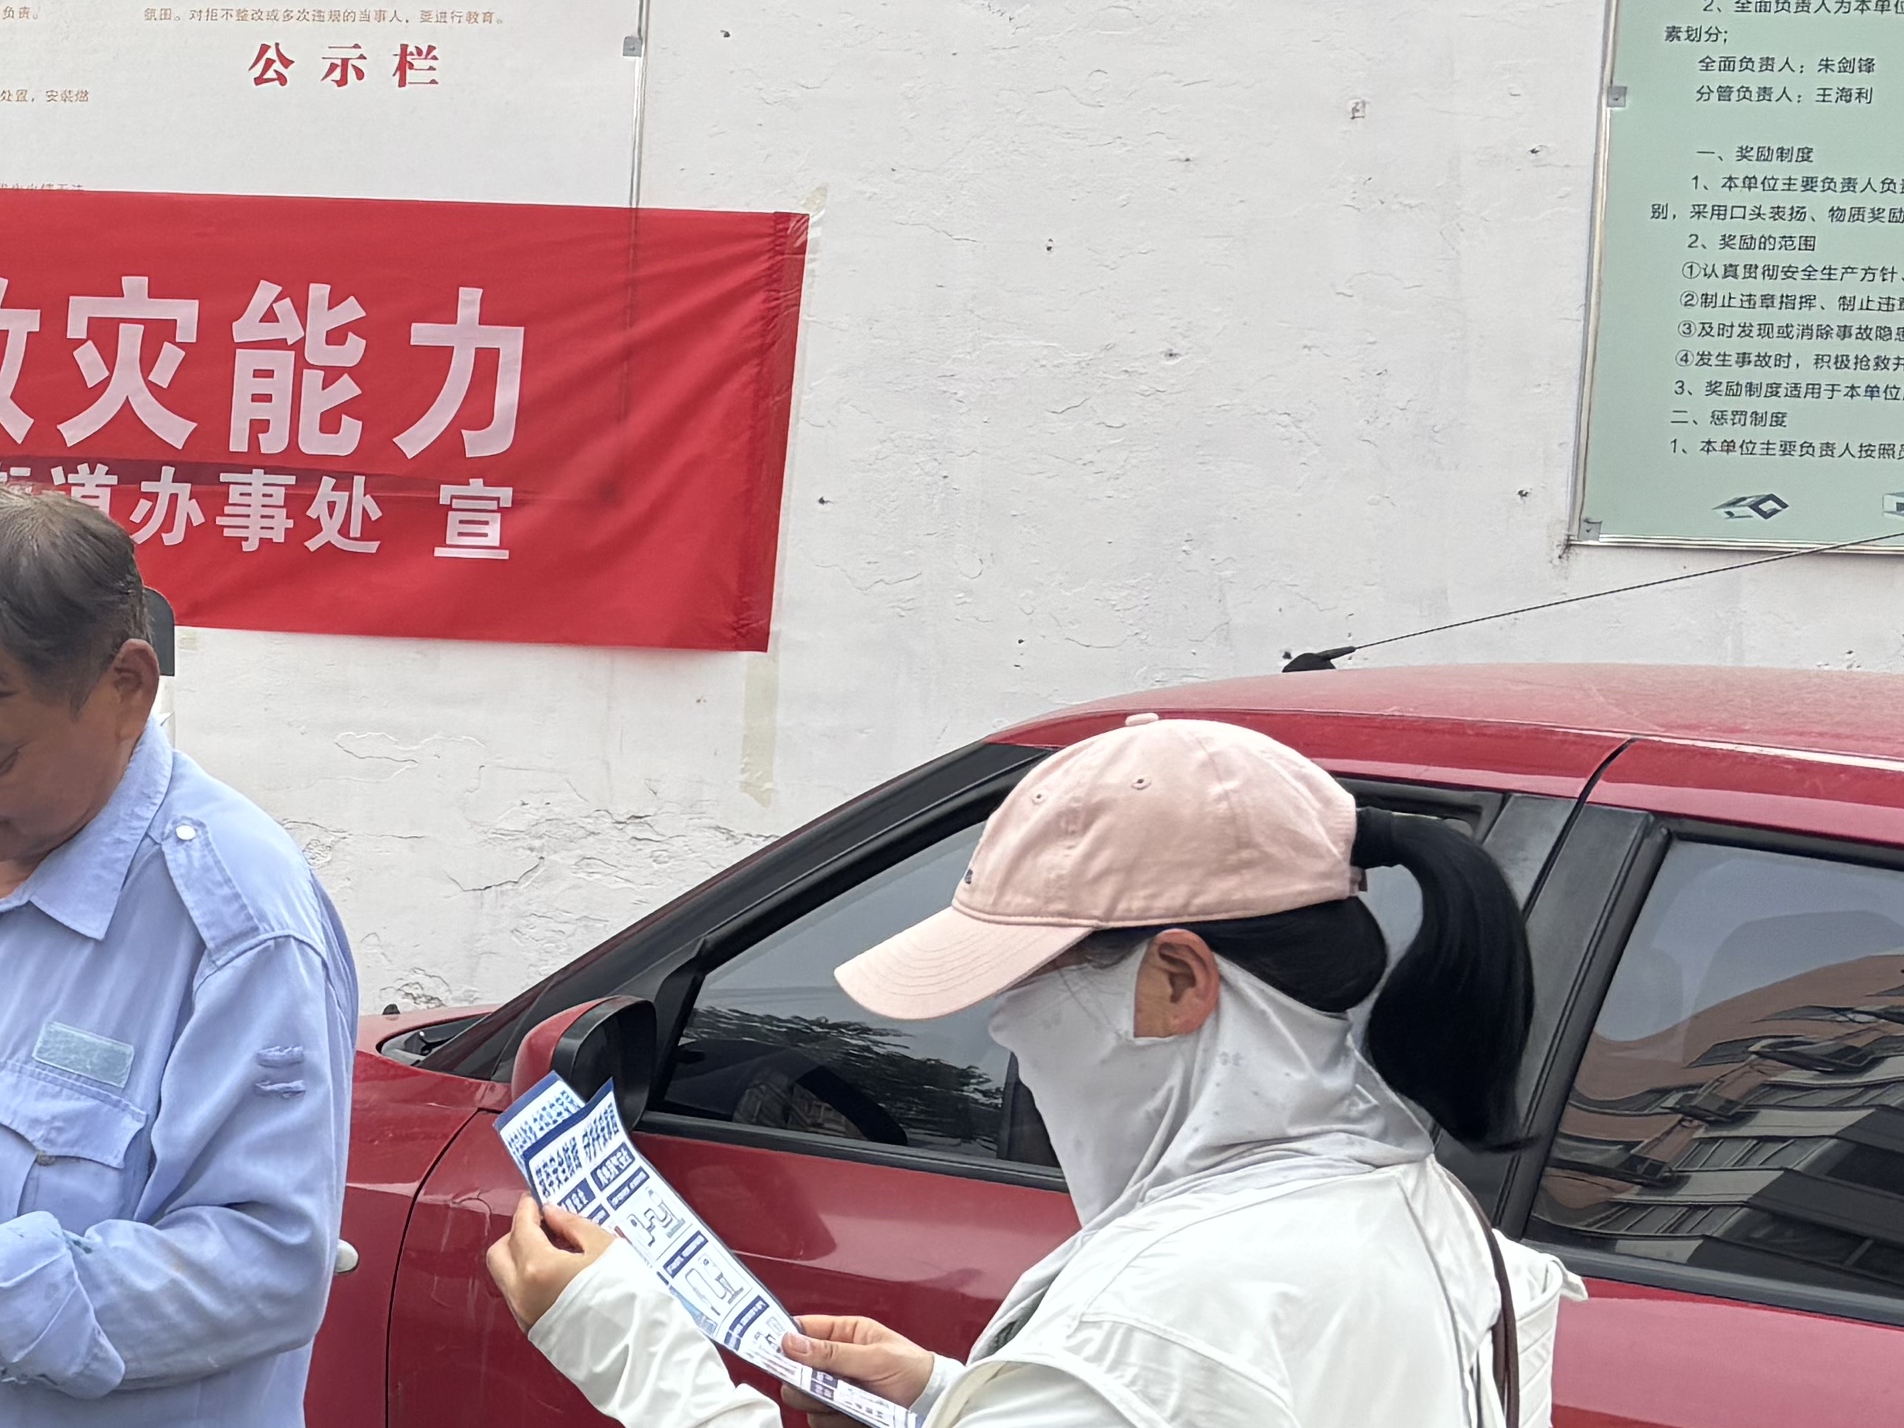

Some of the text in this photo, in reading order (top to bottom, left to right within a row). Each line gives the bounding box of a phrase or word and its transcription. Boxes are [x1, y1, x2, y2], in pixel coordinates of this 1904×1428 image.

[247, 41, 444, 89] 公示栏
[1695, 85, 1873, 105] 分管负责人：王海利
[1696, 145, 1814, 164] 一、奖励制度
[1692, 175, 1904, 194] 1、本单位主要负责人负
[1687, 233, 1817, 252] 2、奖励的范围
[1674, 379, 1904, 401] 3、奖励制度适用于本单位
[1670, 408, 1789, 428] 二、惩罚制度
[434, 478, 513, 560] 宣
